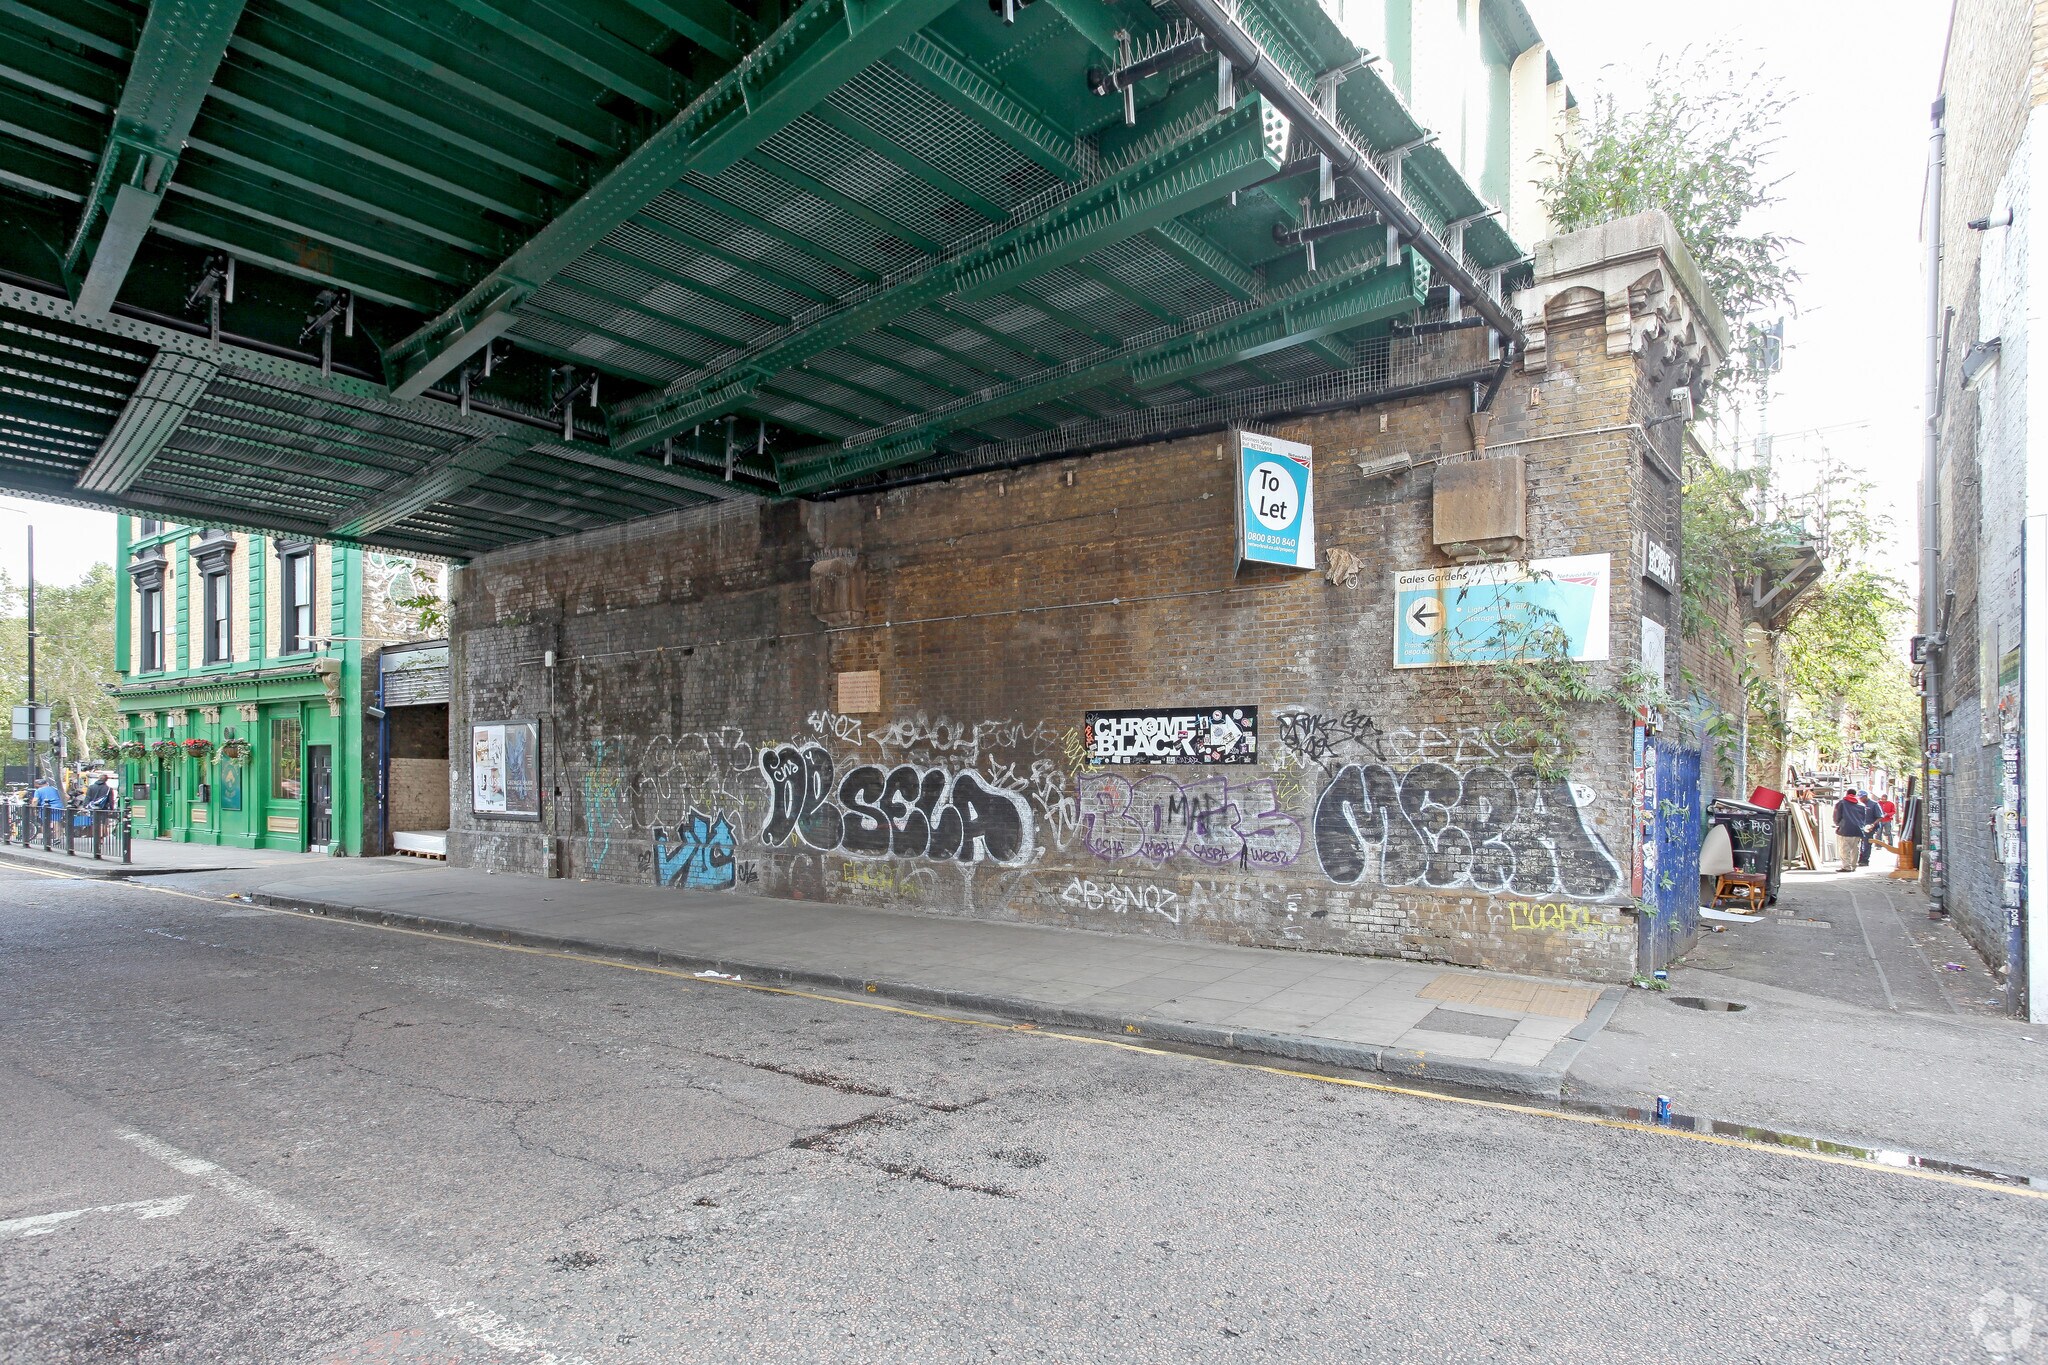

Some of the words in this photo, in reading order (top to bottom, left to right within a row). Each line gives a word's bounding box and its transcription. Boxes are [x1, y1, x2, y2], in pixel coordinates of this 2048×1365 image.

[1260, 469, 1279, 492] To
[1260, 496, 1287, 520] Let
[1247, 532, 1266, 543] 0800
[1267, 535, 1281, 545] 830
[1282, 537, 1296, 547] 840
[1399, 574, 1425, 585] Gales
[1427, 572, 1468, 583] Gardens
[187, 690, 214, 703] SALMON
[222, 688, 239, 701] BALL
[1095, 715, 1197, 738] CHROME
[1095, 731, 1196, 756] BLACK
